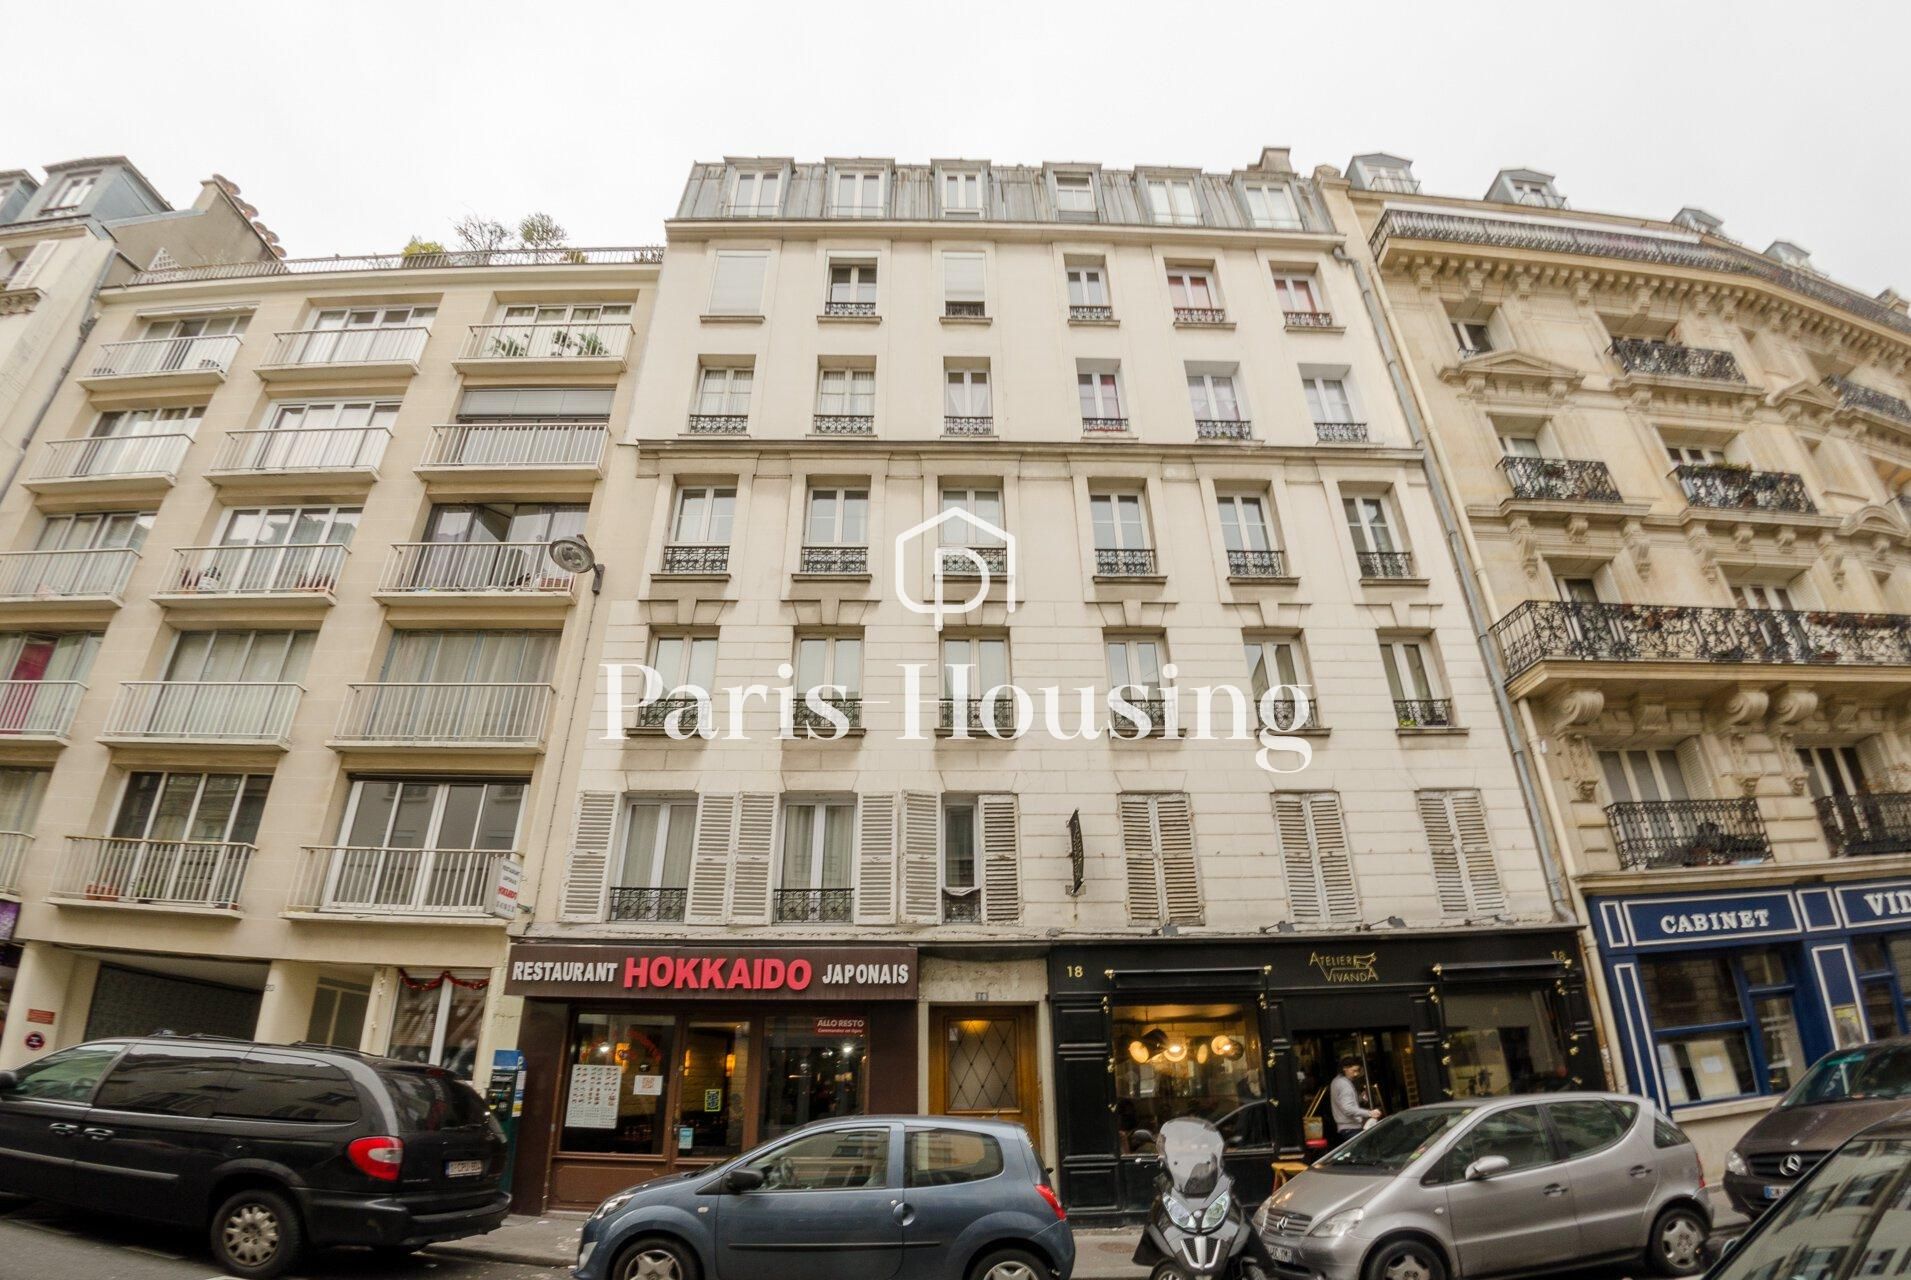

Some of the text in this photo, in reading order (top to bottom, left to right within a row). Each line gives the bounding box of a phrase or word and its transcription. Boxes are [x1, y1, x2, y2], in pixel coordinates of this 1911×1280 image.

[1660, 909, 1770, 934] CABINET
[512, 956, 910, 991] RESTAURANT HOKKAIDO JAPONAIS
[1066, 965, 1083, 978] 18
